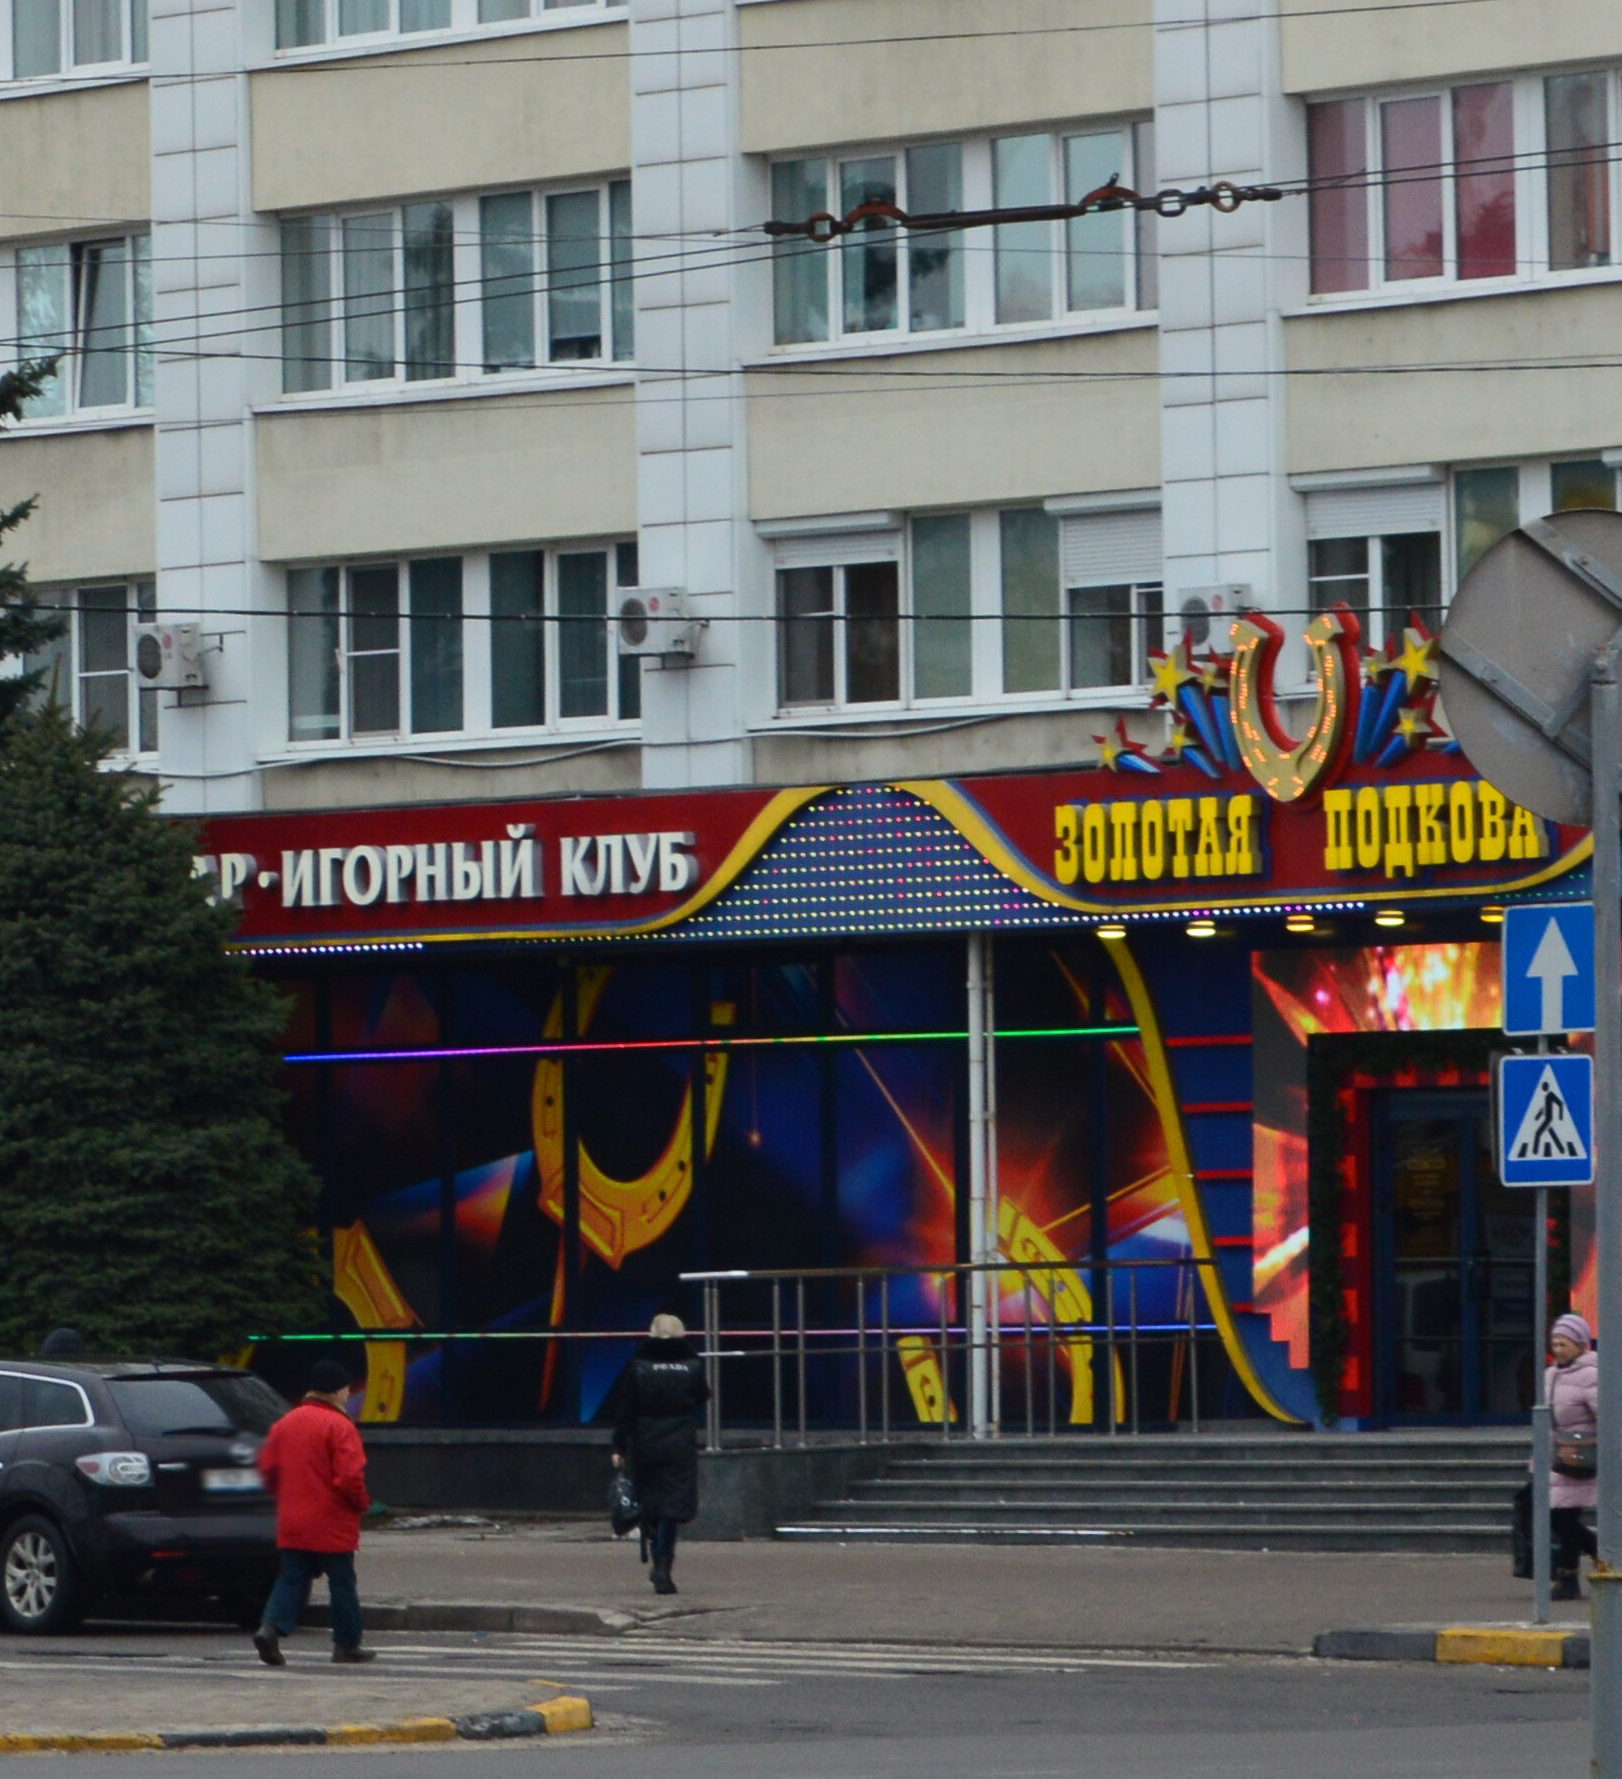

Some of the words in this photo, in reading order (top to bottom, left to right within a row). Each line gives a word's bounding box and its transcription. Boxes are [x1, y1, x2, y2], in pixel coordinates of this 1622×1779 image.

[280, 823, 545, 908] ИГОРНЫЙ
[560, 831, 699, 897] КЛУБ
[1054, 794, 1265, 885] ЗОЛОТАЯ
[1323, 780, 1551, 878] ПОДКОВА
